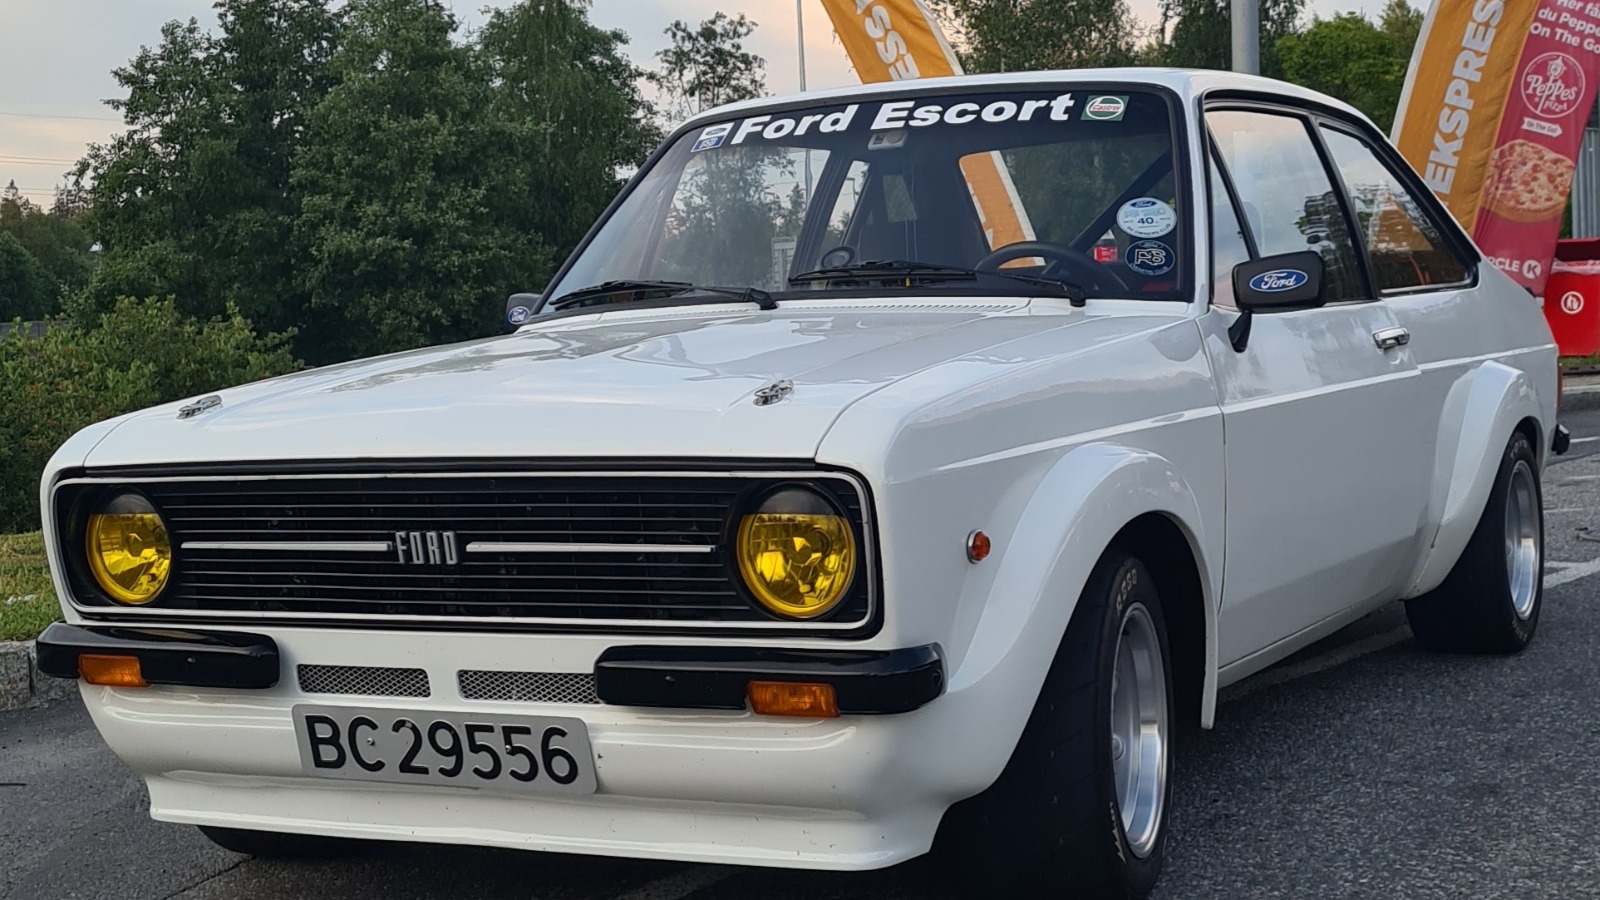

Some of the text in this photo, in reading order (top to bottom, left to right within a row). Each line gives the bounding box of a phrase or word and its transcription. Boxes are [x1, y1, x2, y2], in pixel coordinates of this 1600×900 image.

[1538, 7, 1558, 21] du
[1530, 22, 1600, 54] On The Go
[1525, 74, 1578, 101] Peppes
[731, 93, 1074, 144] Ford Escort
[1261, 272, 1297, 289] Ford
[395, 531, 458, 565] FORD
[304, 714, 579, 785] BC 29556
